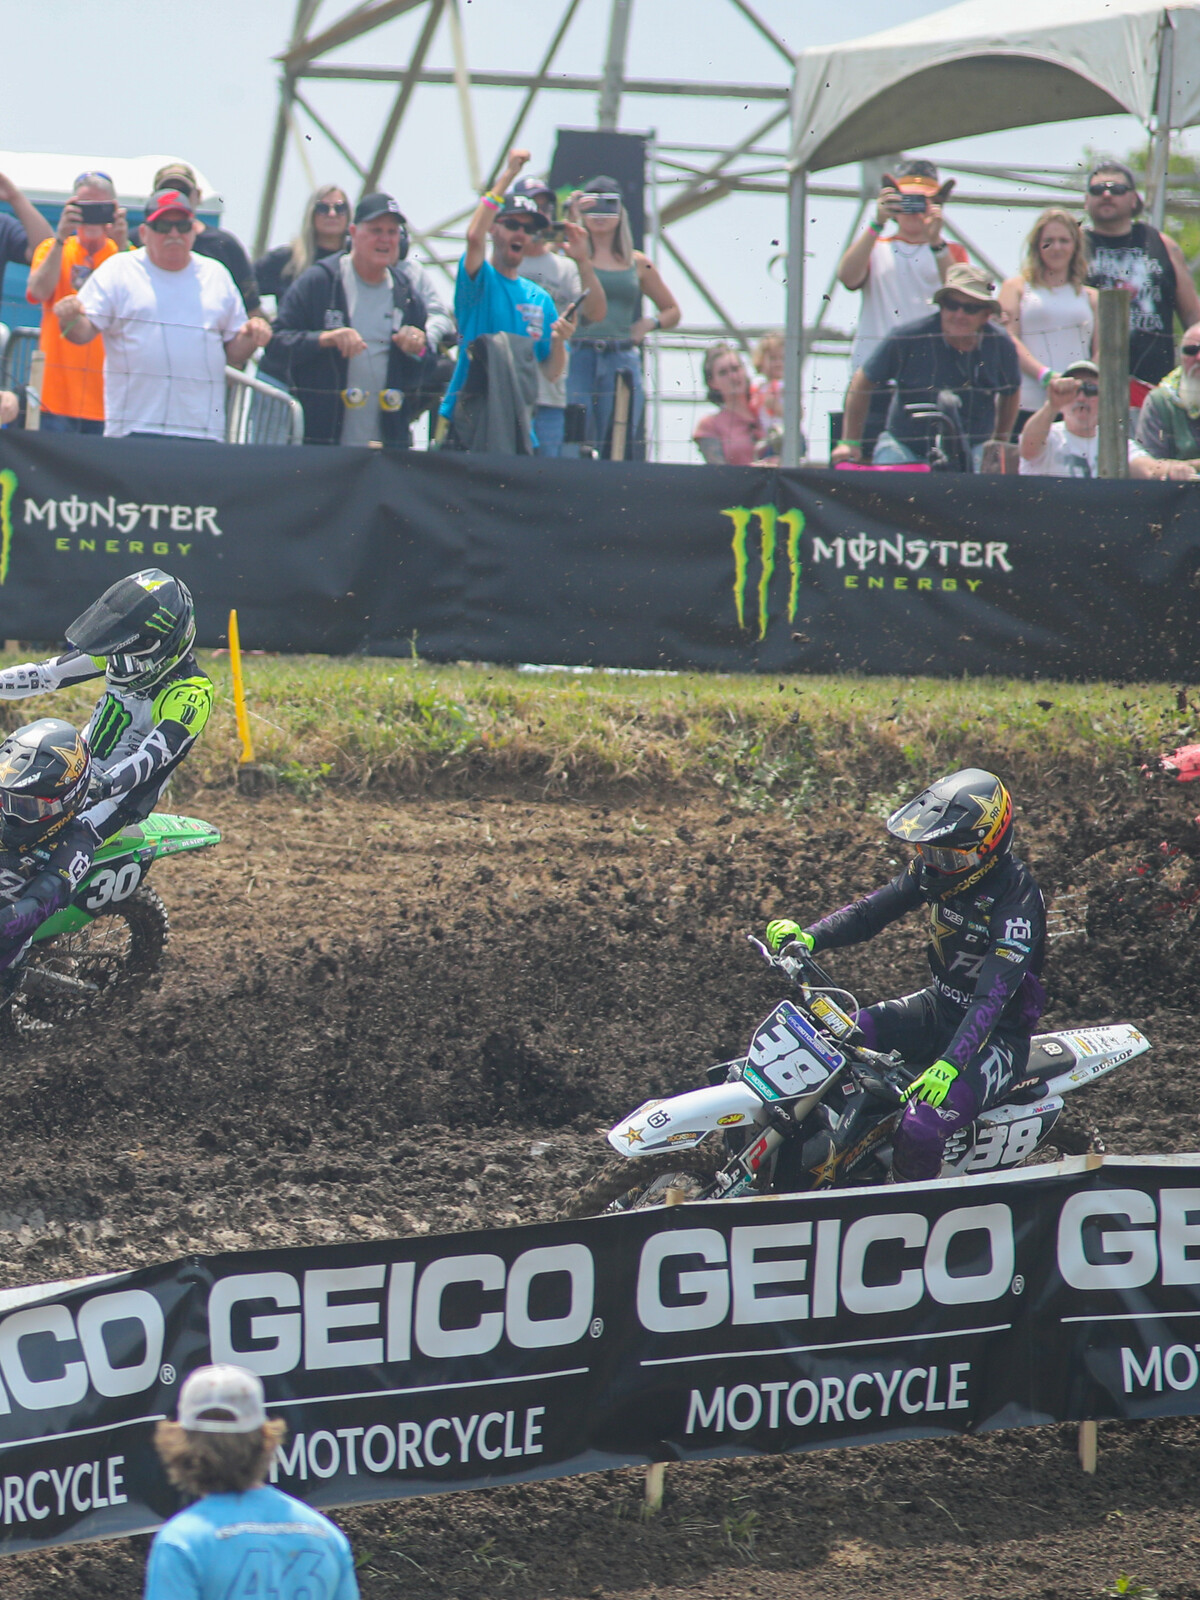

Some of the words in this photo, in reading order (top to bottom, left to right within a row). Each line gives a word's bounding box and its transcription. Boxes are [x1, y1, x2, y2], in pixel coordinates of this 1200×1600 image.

[24, 494, 222, 536] MONSTER
[55, 538, 192, 556] ENERGY
[812, 532, 1013, 573] MONSTER
[844, 574, 984, 592] ENERGY
[174, 690, 206, 709] FOX
[85, 861, 142, 911] 30
[748, 1023, 830, 1096] 38
[929, 1067, 950, 1081] FLY
[1091, 1048, 1133, 1074] DUNLOP
[966, 1116, 1043, 1171] 38
[637, 1203, 1015, 1333] GEICO
[208, 1243, 595, 1376] GEICO
[686, 1362, 971, 1435] MOTORCYCLE
[269, 1406, 546, 1484] MOTORCYCLE
